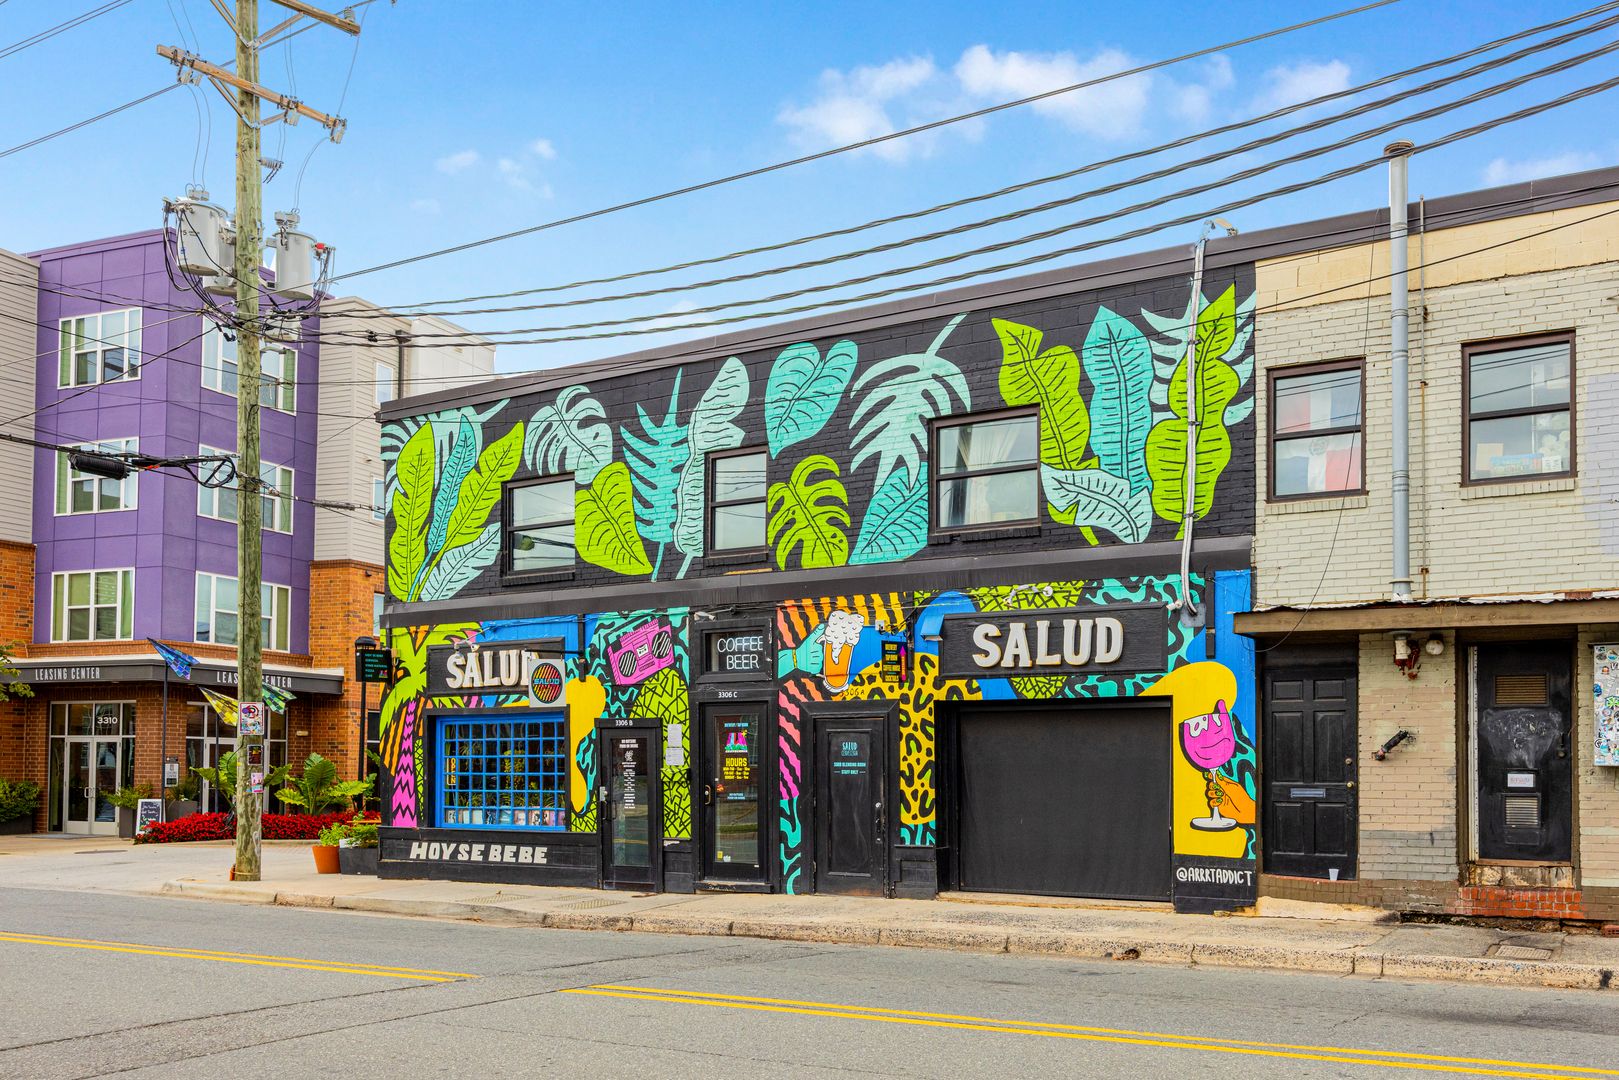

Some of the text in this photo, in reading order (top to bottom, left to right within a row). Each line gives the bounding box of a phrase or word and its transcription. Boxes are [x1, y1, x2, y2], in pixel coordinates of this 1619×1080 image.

[717, 635, 763, 653] COFFEE
[972, 617, 1124, 668] SALUD
[726, 653, 760, 670] BEER
[35, 666, 100, 681] LEASING CENTER
[216, 670, 238, 684] LEAS
[97, 716, 118, 725] 3310
[615, 719, 628, 727] 3306
[725, 757, 748, 767] HOURS
[409, 841, 548, 864] HOY SE BEBE
[1176, 866, 1253, 886] @ARRRTADDICT
